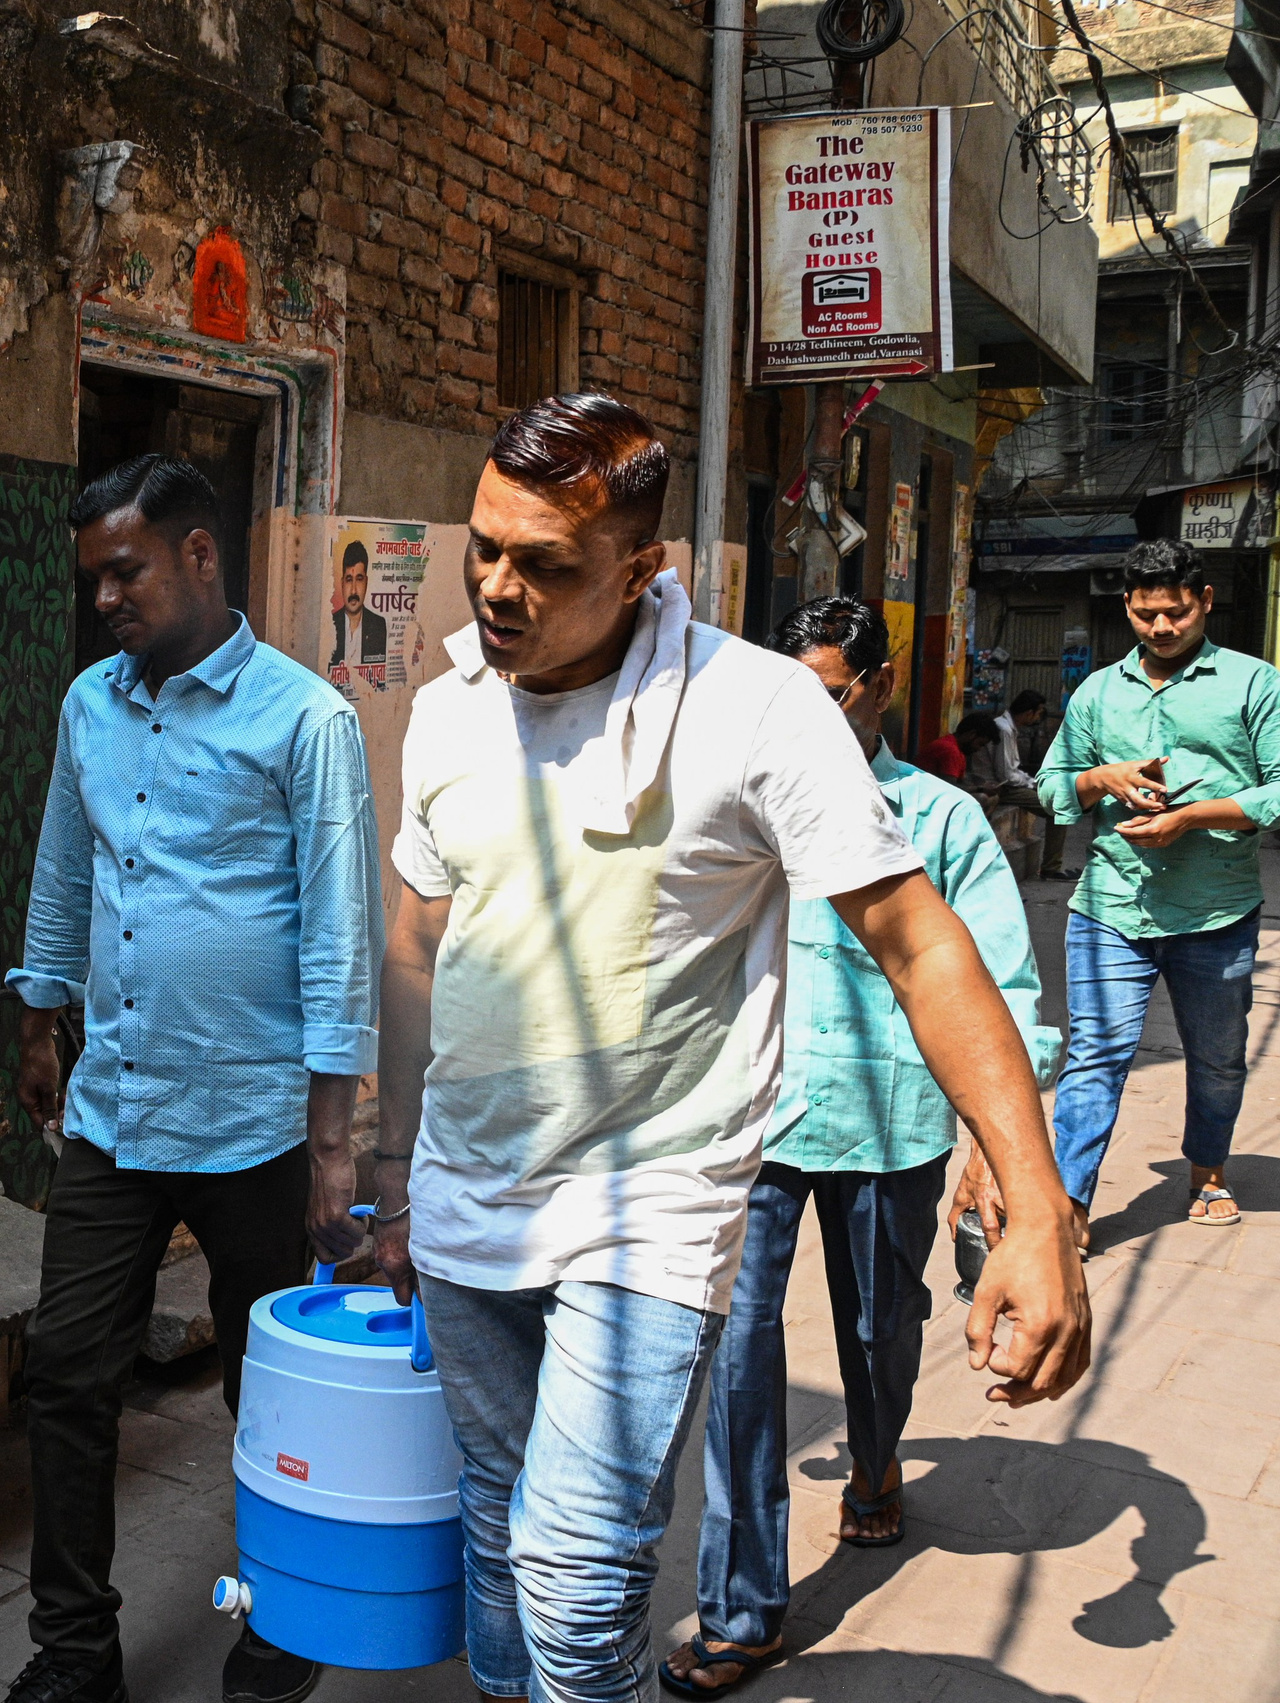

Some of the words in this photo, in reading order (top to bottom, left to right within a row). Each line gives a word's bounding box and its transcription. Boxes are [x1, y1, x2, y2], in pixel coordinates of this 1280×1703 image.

[831, 118, 853, 127] Mob
[861, 116, 878, 125] 760
[881, 115, 898, 123] 788
[900, 114, 923, 123] 6063
[861, 127, 878, 135] 798
[881, 126, 897, 134] 507
[901, 124, 923, 133] 1230
[816, 135, 864, 157] The
[785, 161, 895, 185] Gateway
[787, 187, 894, 211] Banaras
[822, 210, 859, 228] (P)
[808, 228, 875, 248] Guest
[805, 251, 878, 269] House
[818, 312, 832, 322] AC
[835, 311, 868, 320] Rooms
[807, 325, 827, 334] Non
[829, 323, 843, 332] AC
[846, 322, 879, 331] Rooms
[769, 344, 778, 352] D
[781, 340, 806, 351] 14/28
[809, 337, 866, 350] Tedhineem,
[869, 334, 920, 346] Godowlia,
[767, 352, 851, 365] Dashashwamedh
[992, 542, 1012, 553] SBI
[371, 585, 419, 614] पार्षद
[279, 1459, 305, 1473] MILTON
